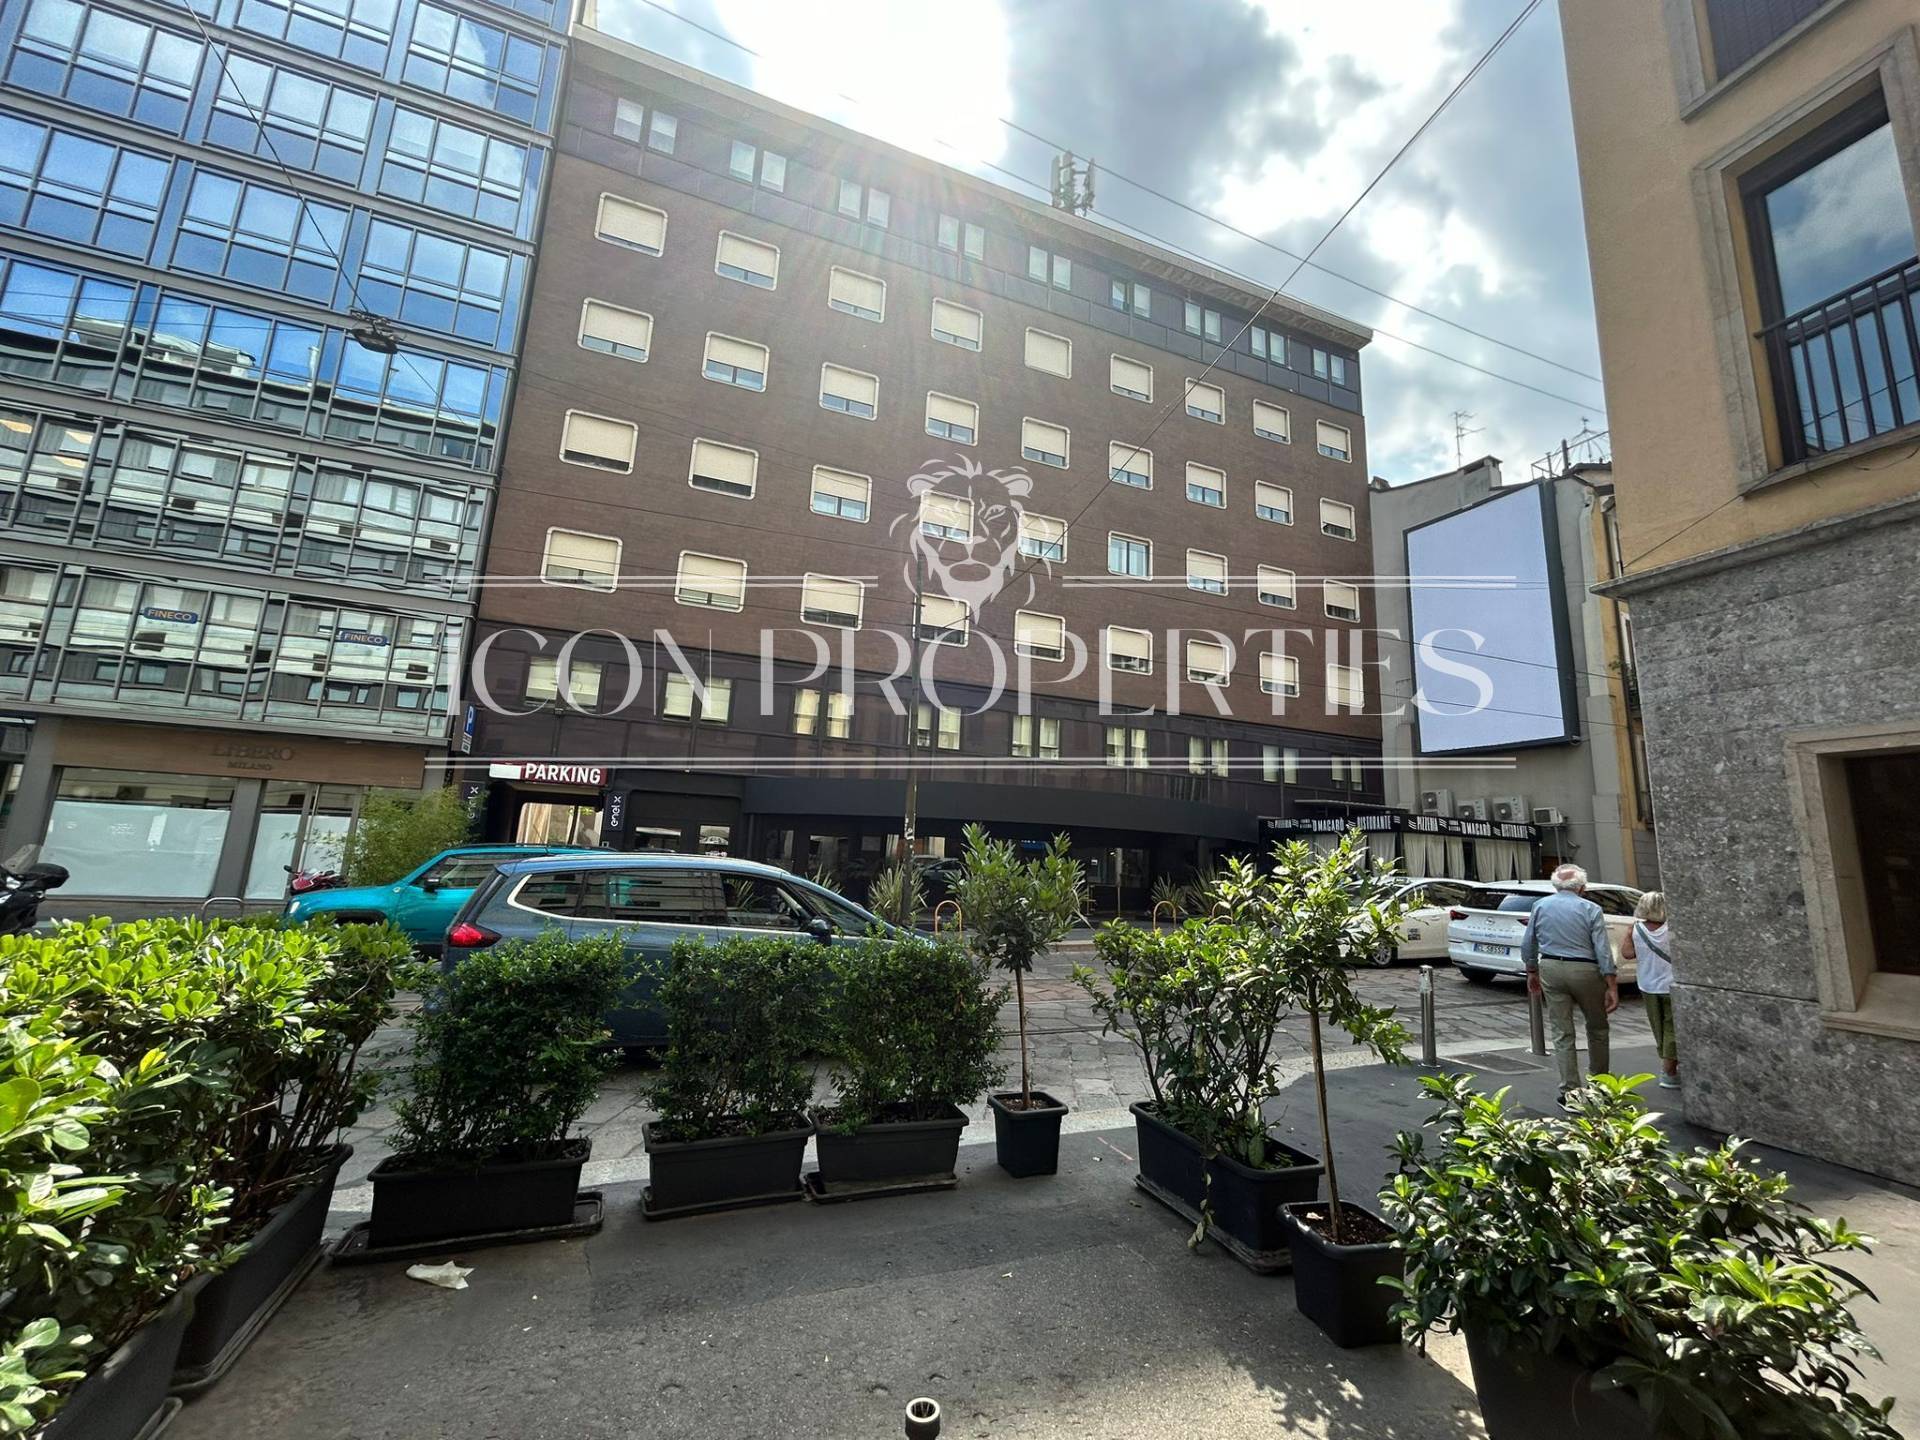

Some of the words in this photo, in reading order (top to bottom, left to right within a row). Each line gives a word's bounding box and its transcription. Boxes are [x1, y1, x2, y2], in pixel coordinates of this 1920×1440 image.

[147, 608, 192, 622] FINECO
[343, 632, 384, 645] FINECO
[525, 762, 601, 784] PARKING
[610, 803, 621, 827] enel
